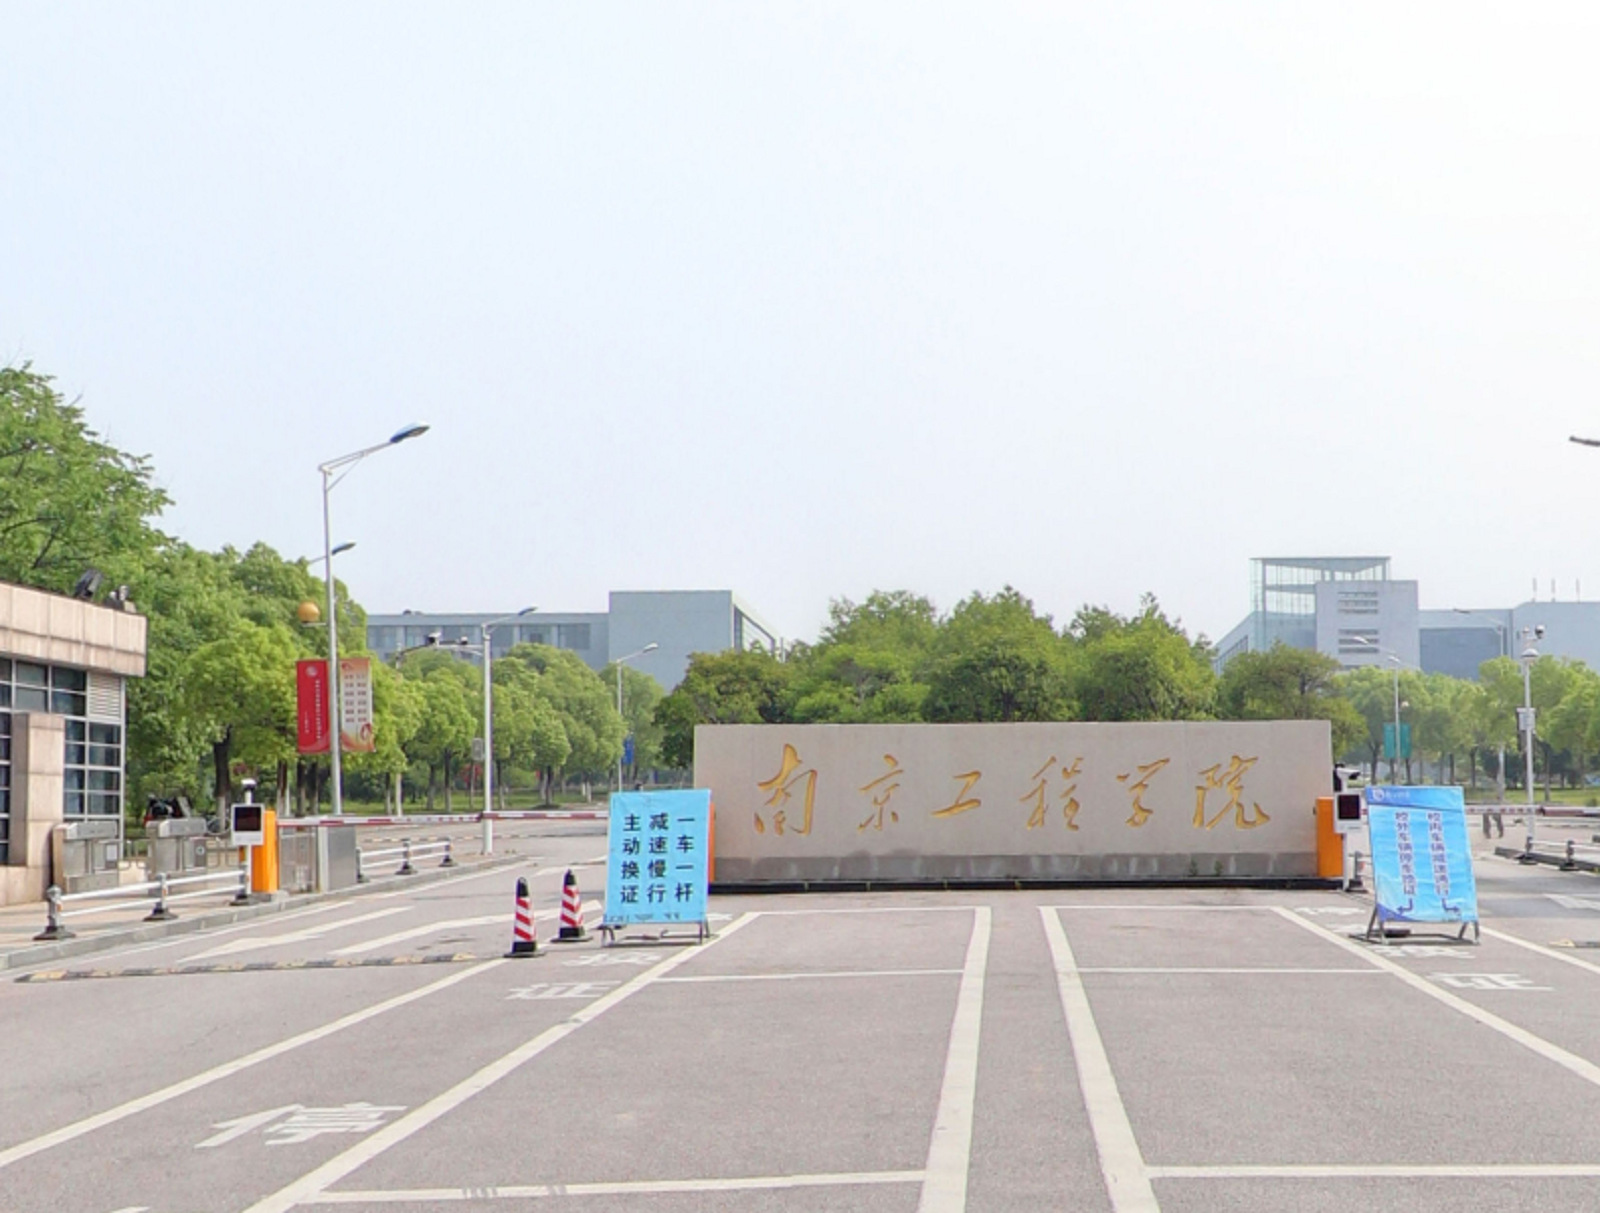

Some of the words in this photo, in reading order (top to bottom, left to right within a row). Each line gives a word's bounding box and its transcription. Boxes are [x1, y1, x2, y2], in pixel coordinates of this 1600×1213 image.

[754, 742, 1271, 836] 南京工程学院
[620, 813, 641, 904] 主动换证
[647, 812, 669, 904] 减速慢行
[674, 817, 695, 903] 一车一杆
